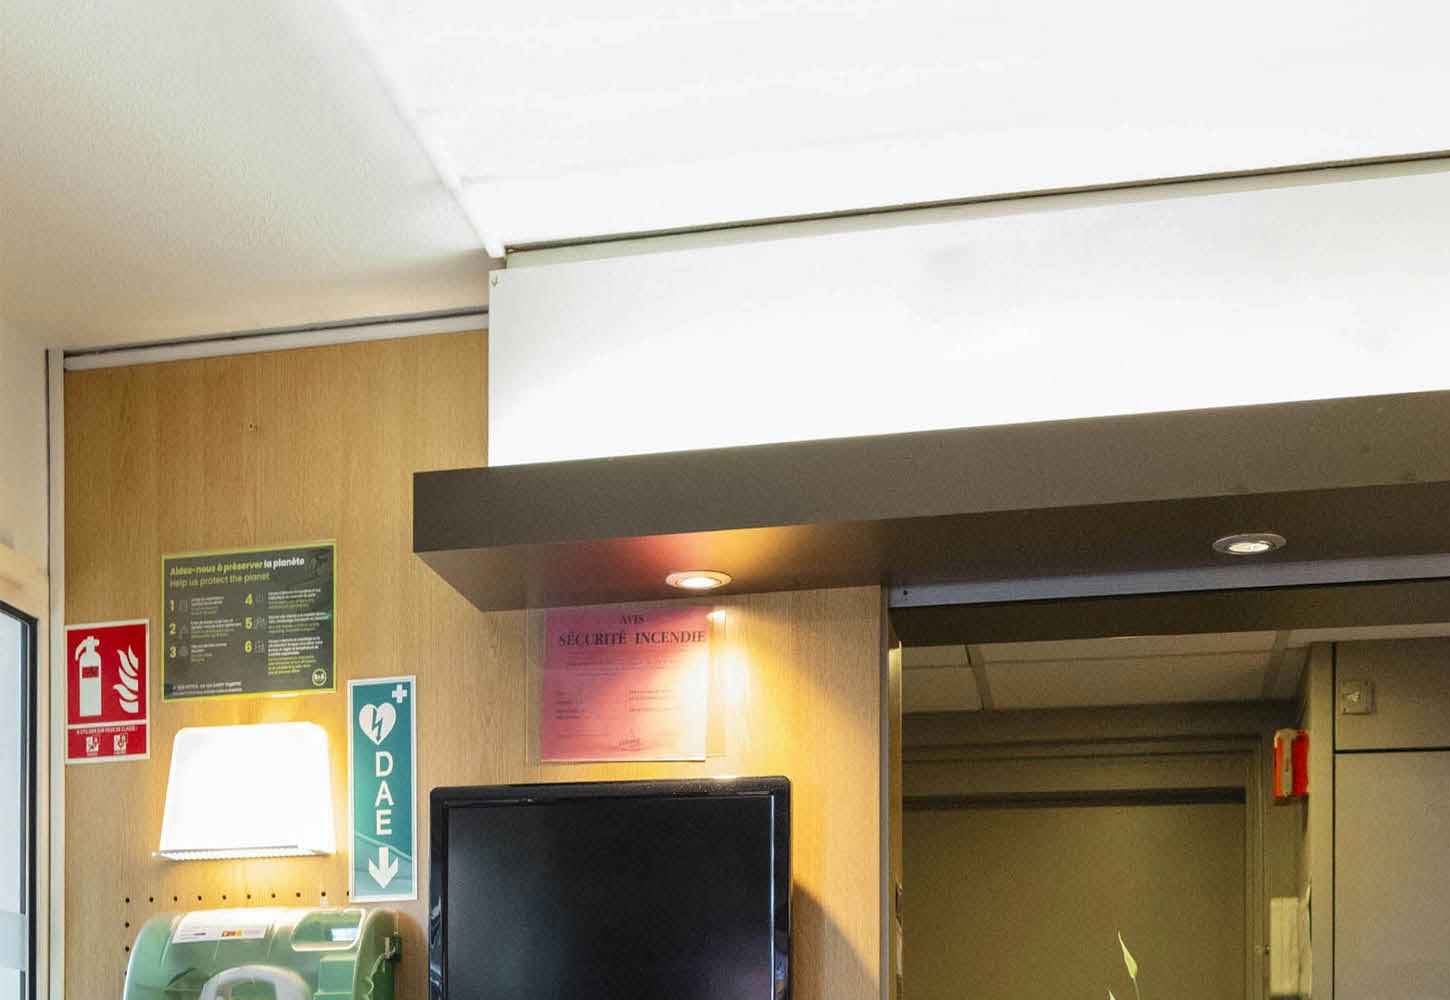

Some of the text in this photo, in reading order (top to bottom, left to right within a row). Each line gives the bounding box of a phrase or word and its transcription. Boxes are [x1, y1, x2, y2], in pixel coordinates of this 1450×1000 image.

[264, 559, 272, 569] la
[169, 599, 175, 611] 1
[245, 593, 253, 606] 4
[245, 617, 253, 630] 5
[619, 614, 646, 625] AVIS
[169, 623, 177, 635] 2
[559, 629, 705, 647] SÉCURITÉ INCENDIE
[244, 640, 253, 653] 6
[169, 647, 177, 659] 3
[373, 750, 395, 836] DAE
